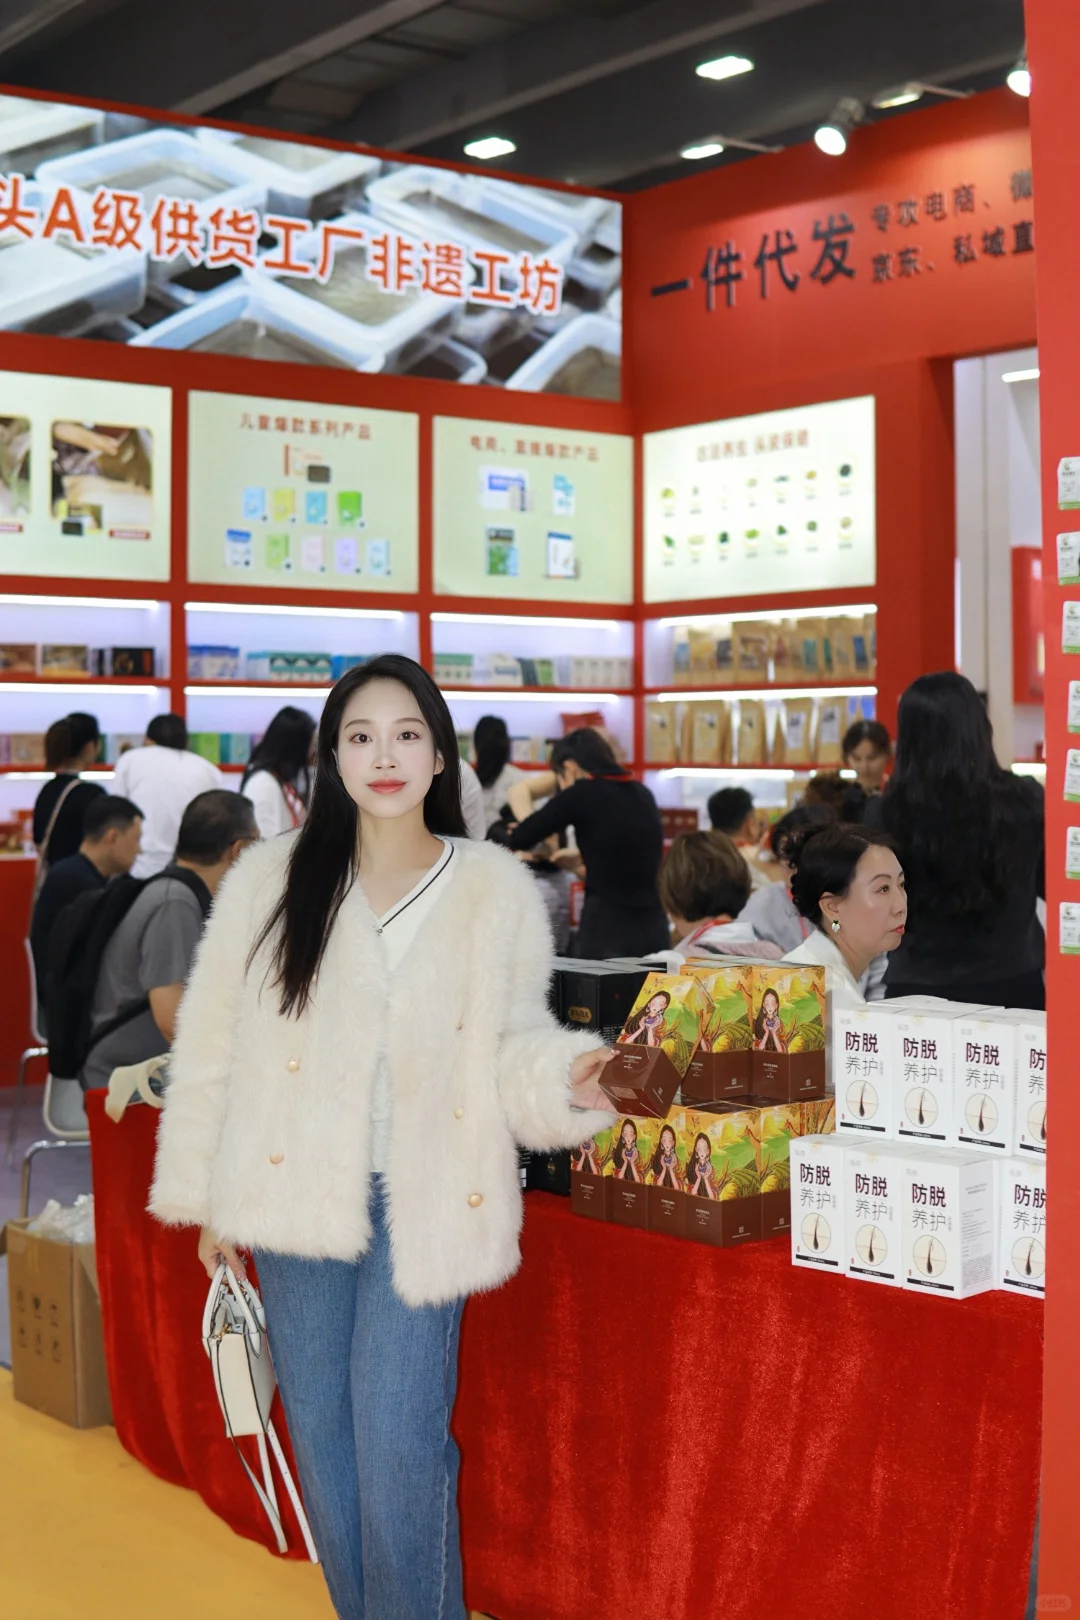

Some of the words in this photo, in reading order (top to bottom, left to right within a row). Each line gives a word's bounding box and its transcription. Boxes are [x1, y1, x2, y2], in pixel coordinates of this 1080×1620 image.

[651, 212, 856, 310] 一件代发
[845, 1031, 879, 1054] 防脱
[903, 1037, 938, 1060] 防脱
[965, 1042, 1000, 1066] 防脱
[845, 1056, 878, 1077] 养护
[904, 1062, 938, 1084] 养护
[965, 1068, 999, 1090] 养护
[800, 1163, 832, 1187] 防脱
[855, 1173, 888, 1198] 防脱
[800, 1188, 832, 1210] 养护
[911, 1183, 947, 1208] 防脱
[855, 1198, 888, 1221] 养护
[912, 1208, 947, 1232] 养护
